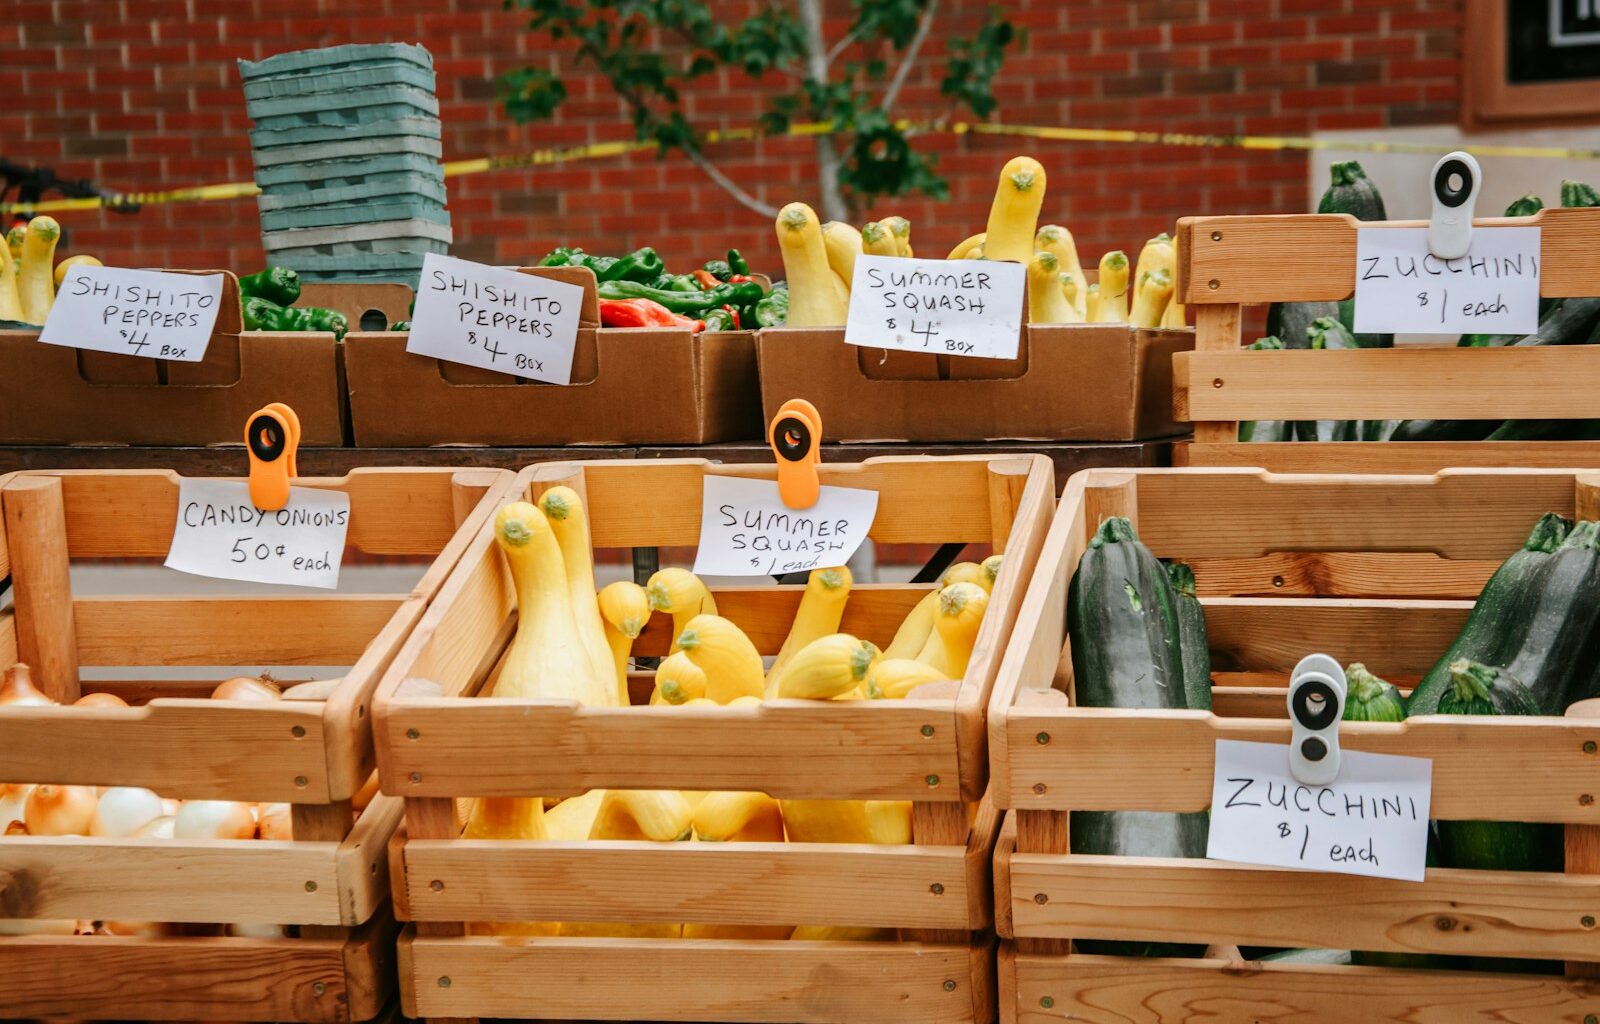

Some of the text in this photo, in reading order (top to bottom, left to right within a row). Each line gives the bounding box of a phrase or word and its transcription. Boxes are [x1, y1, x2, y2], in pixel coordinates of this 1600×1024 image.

[72, 276, 214, 308] SHISHITO
[431, 270, 562, 315] SHISHITO
[867, 268, 992, 290] SUMMER
[103, 305, 199, 327] PEPPERS
[883, 292, 985, 314] SQUASH
[1417, 288, 1447, 323] $1
[458, 302, 553, 338] PEPPERS
[120, 330, 150, 356] $4
[184, 502, 348, 528] CANDY ONIONS
[719, 504, 849, 537] SUMMER
[232, 537, 285, 563] 50¢
[732, 533, 845, 553] SQUASH
[1224, 778, 1417, 820] ZUCCHINI
[1277, 822, 1309, 860] $1
